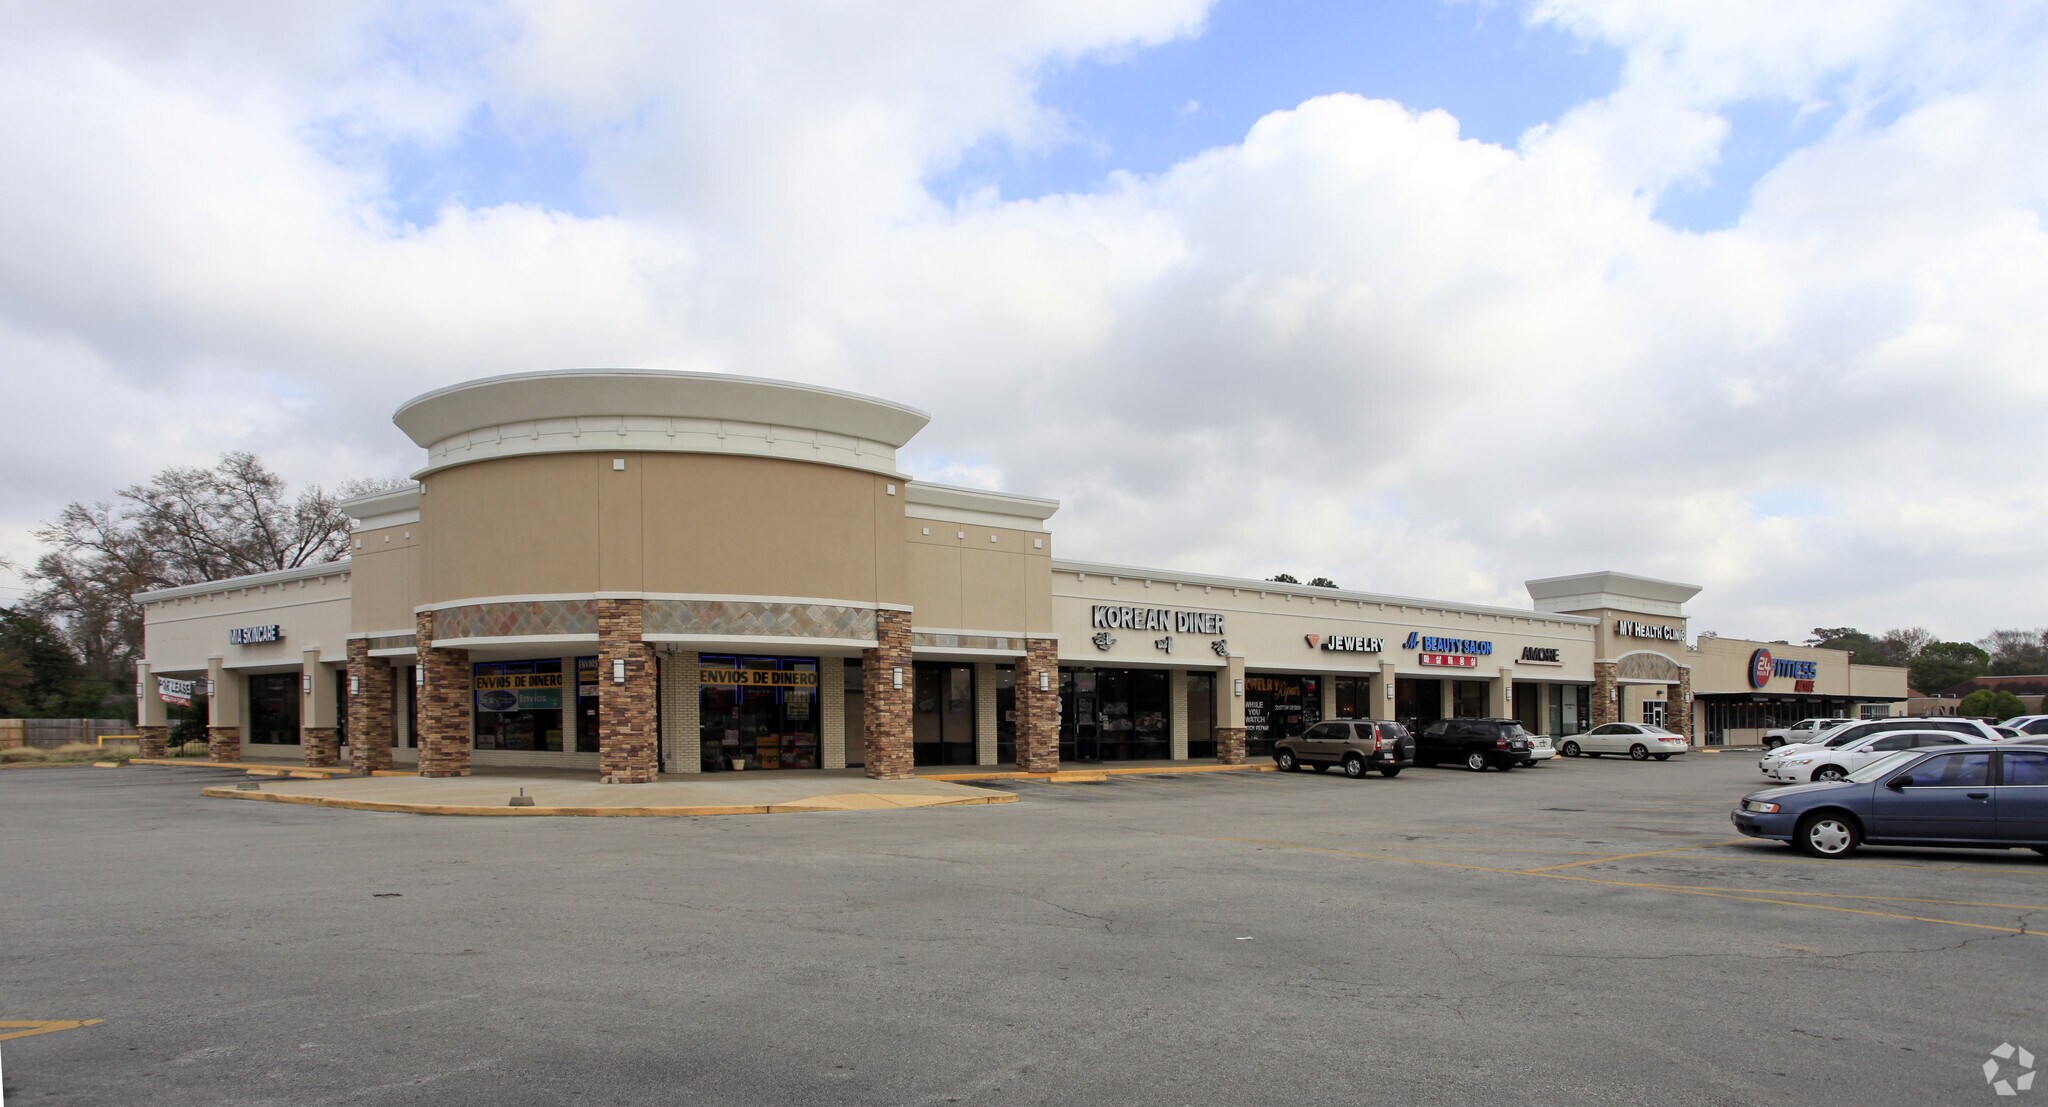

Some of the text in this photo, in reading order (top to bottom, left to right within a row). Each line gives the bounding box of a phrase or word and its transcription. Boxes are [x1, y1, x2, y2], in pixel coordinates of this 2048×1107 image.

[1092, 605, 1225, 635] KOREAN DINER
[229, 625, 276, 645] MIA SKINCARE
[1619, 620, 1686, 641] MY HEALTH CLINIC
[1328, 635, 1386, 653] JEWELRY
[1423, 637, 1461, 653] BEAUTY
[1463, 640, 1492, 655] SALON
[1521, 646, 1560, 662] AMORE
[1758, 657, 1771, 676] 24
[1772, 658, 1817, 679] FITNESS
[477, 676, 511, 689] ENVIOS
[515, 676, 526, 687] DE
[700, 670, 817, 685] ENVIOS DE DINERO
[172, 681, 191, 695] LEASE
[1248, 708, 1261, 716] YOU
